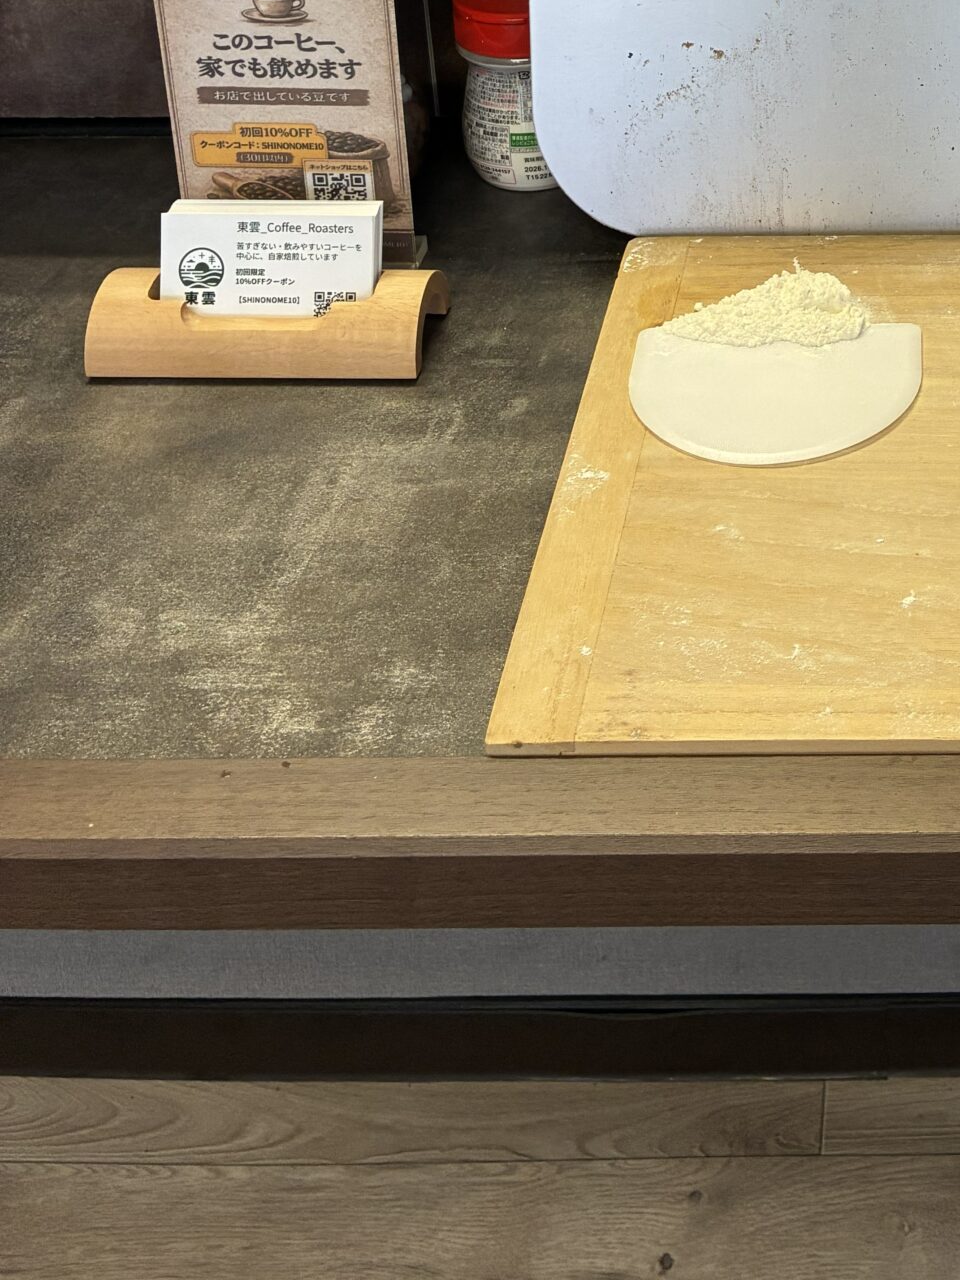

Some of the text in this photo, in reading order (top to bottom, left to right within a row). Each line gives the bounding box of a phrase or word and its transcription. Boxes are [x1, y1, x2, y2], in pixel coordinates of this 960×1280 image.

[212, 33, 346, 54] このコーヒー、
[195, 56, 363, 80] 家でも飲めます
[213, 90, 351, 103] お店で出している豆です
[239, 126, 313, 138] 初回10%OFF
[309, 163, 368, 171] ネットショップはこちら
[236, 221, 354, 234] 東雲_Coffee_Roasters
[236, 242, 362, 252] 苦すぎない・飲みやすいコーヒーを
[235, 252, 339, 262] 中心に、自家焙煎しています
[235, 268, 266, 277] 初回限定
[235, 277, 296, 286] 10%OFFクーポン
[184, 291, 216, 306] 東雲
